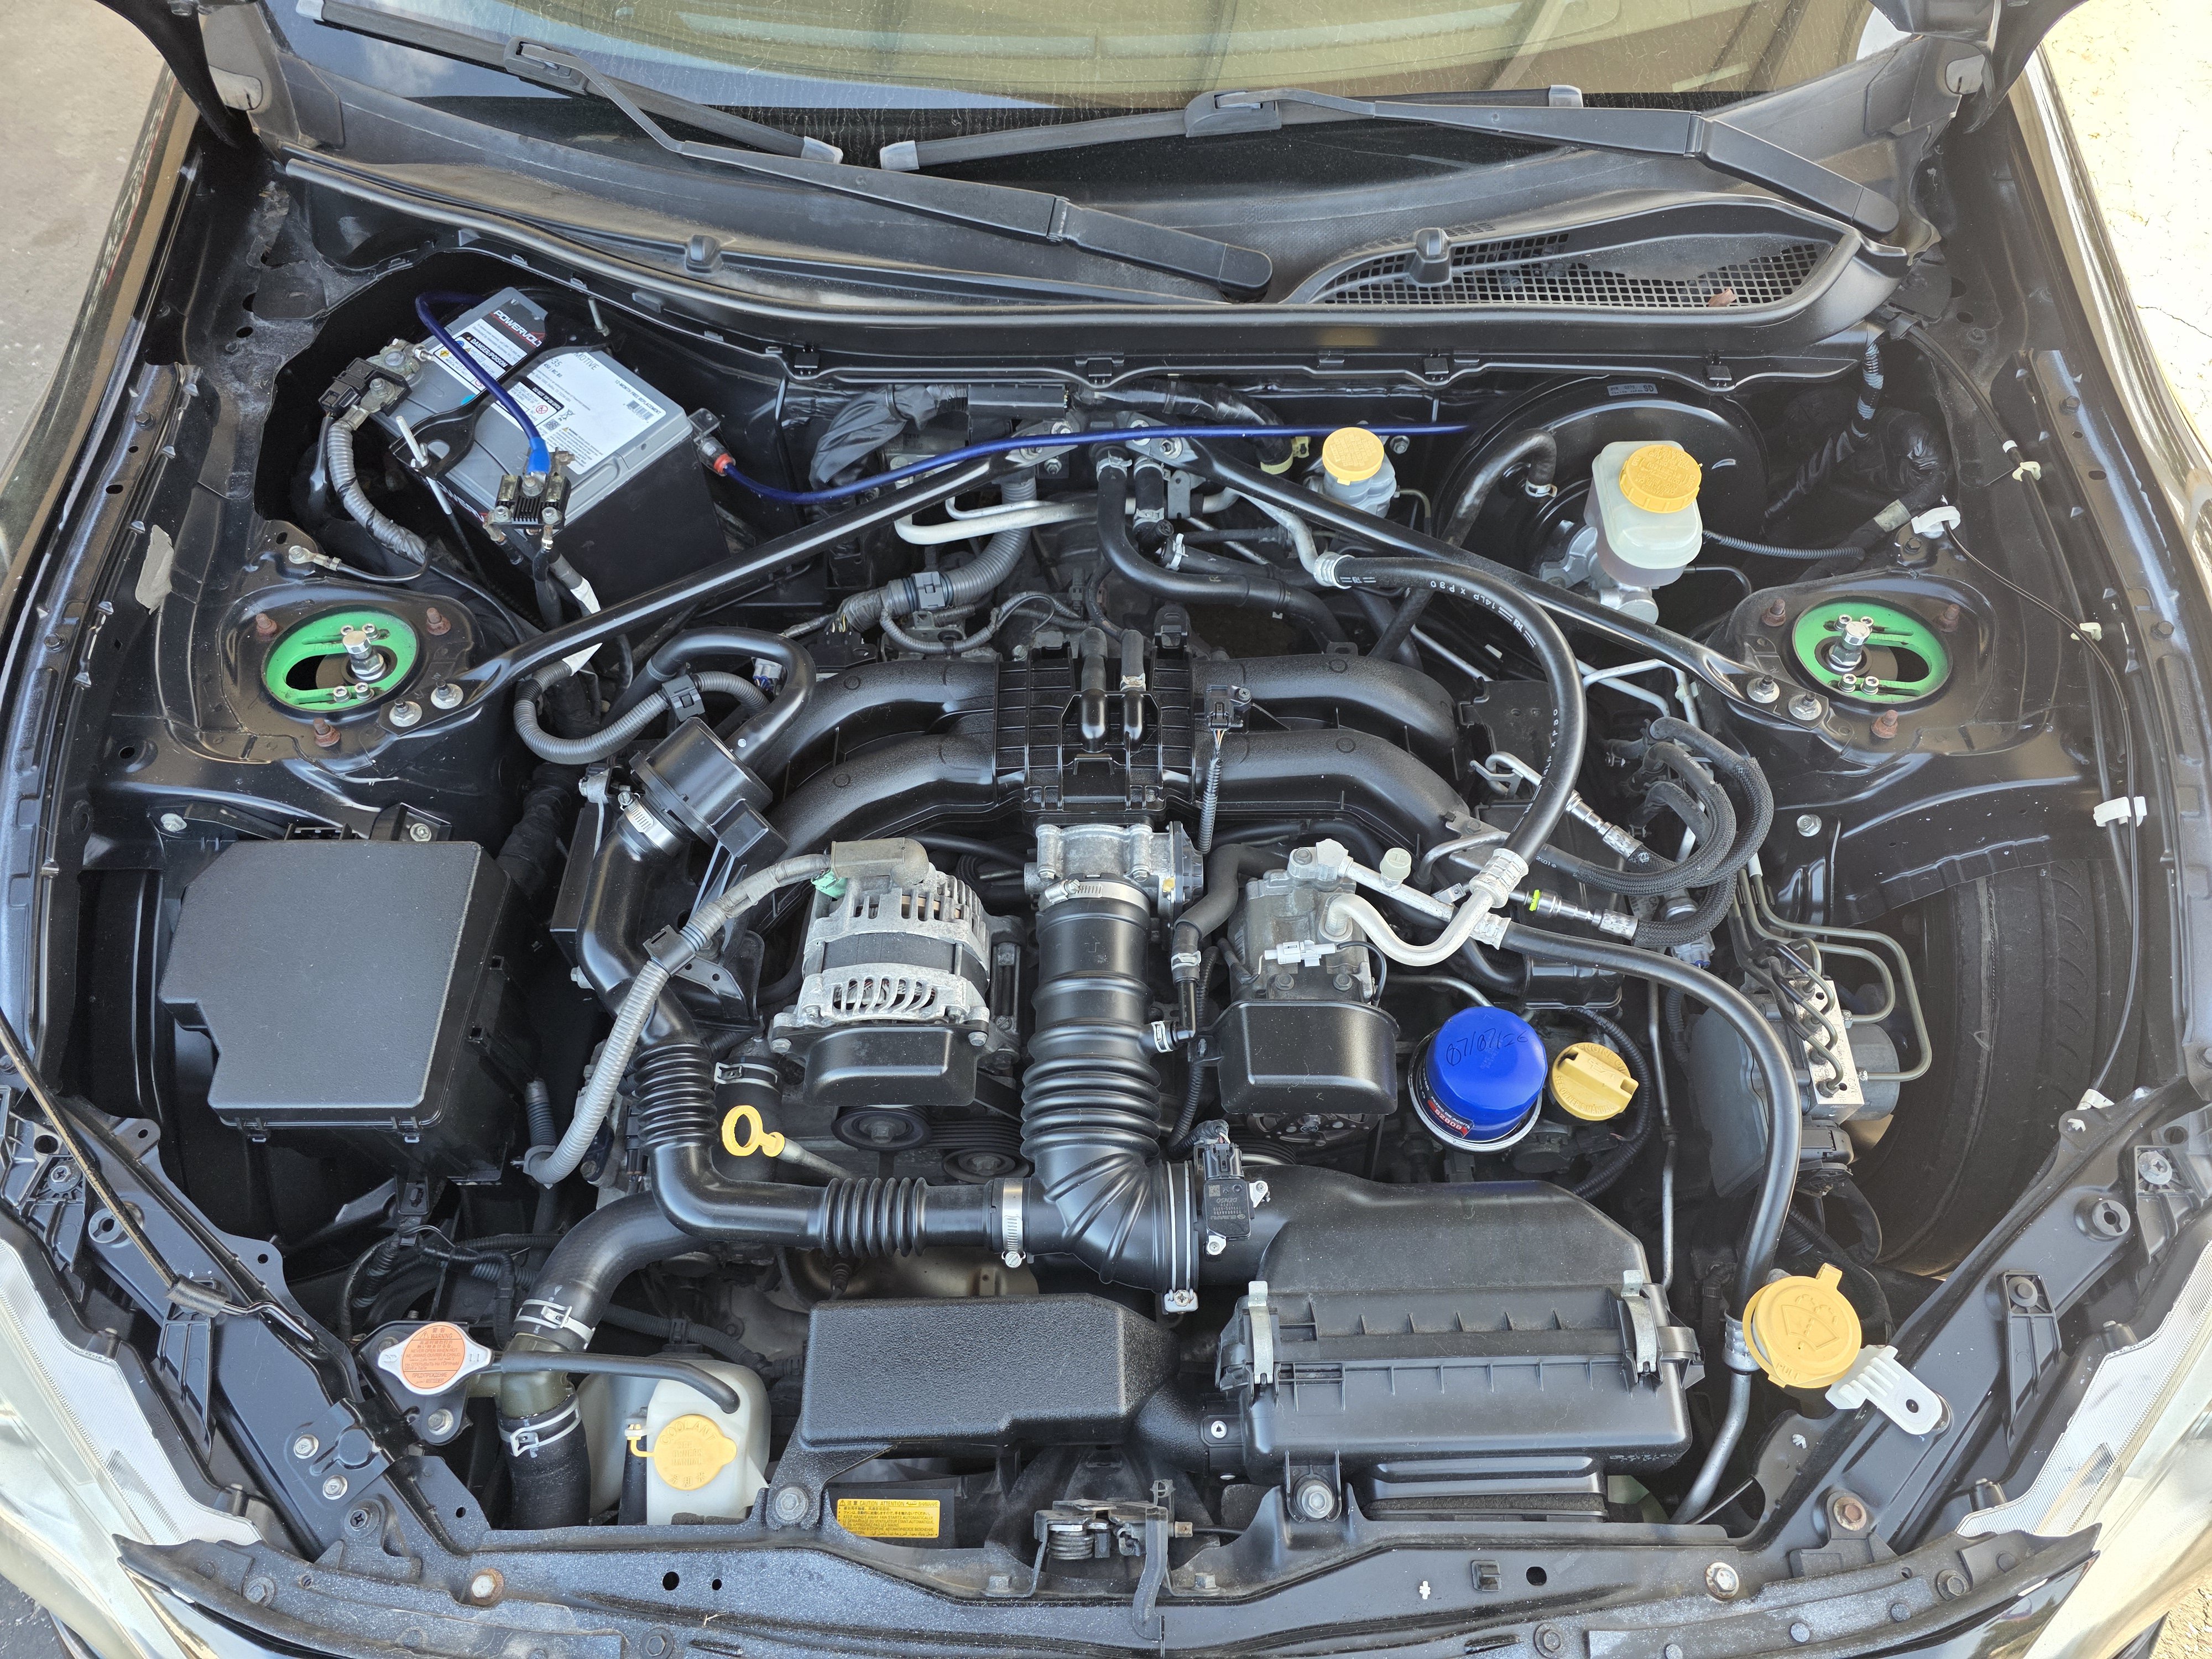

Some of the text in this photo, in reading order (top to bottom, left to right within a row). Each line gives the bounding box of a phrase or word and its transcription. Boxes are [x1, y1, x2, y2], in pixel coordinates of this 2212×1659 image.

[470, 338, 508, 367] DANGER/POISON
[637, 396, 661, 415] REPLACEMENT
[1577, 1044, 1615, 1061] ENGINE
[1554, 1074, 1564, 1089] SEE
[1431, 1096, 1444, 1112] FILTRO
[1776, 1361, 1801, 1380] PULL
[660, 1420, 718, 1446] COOLANT
